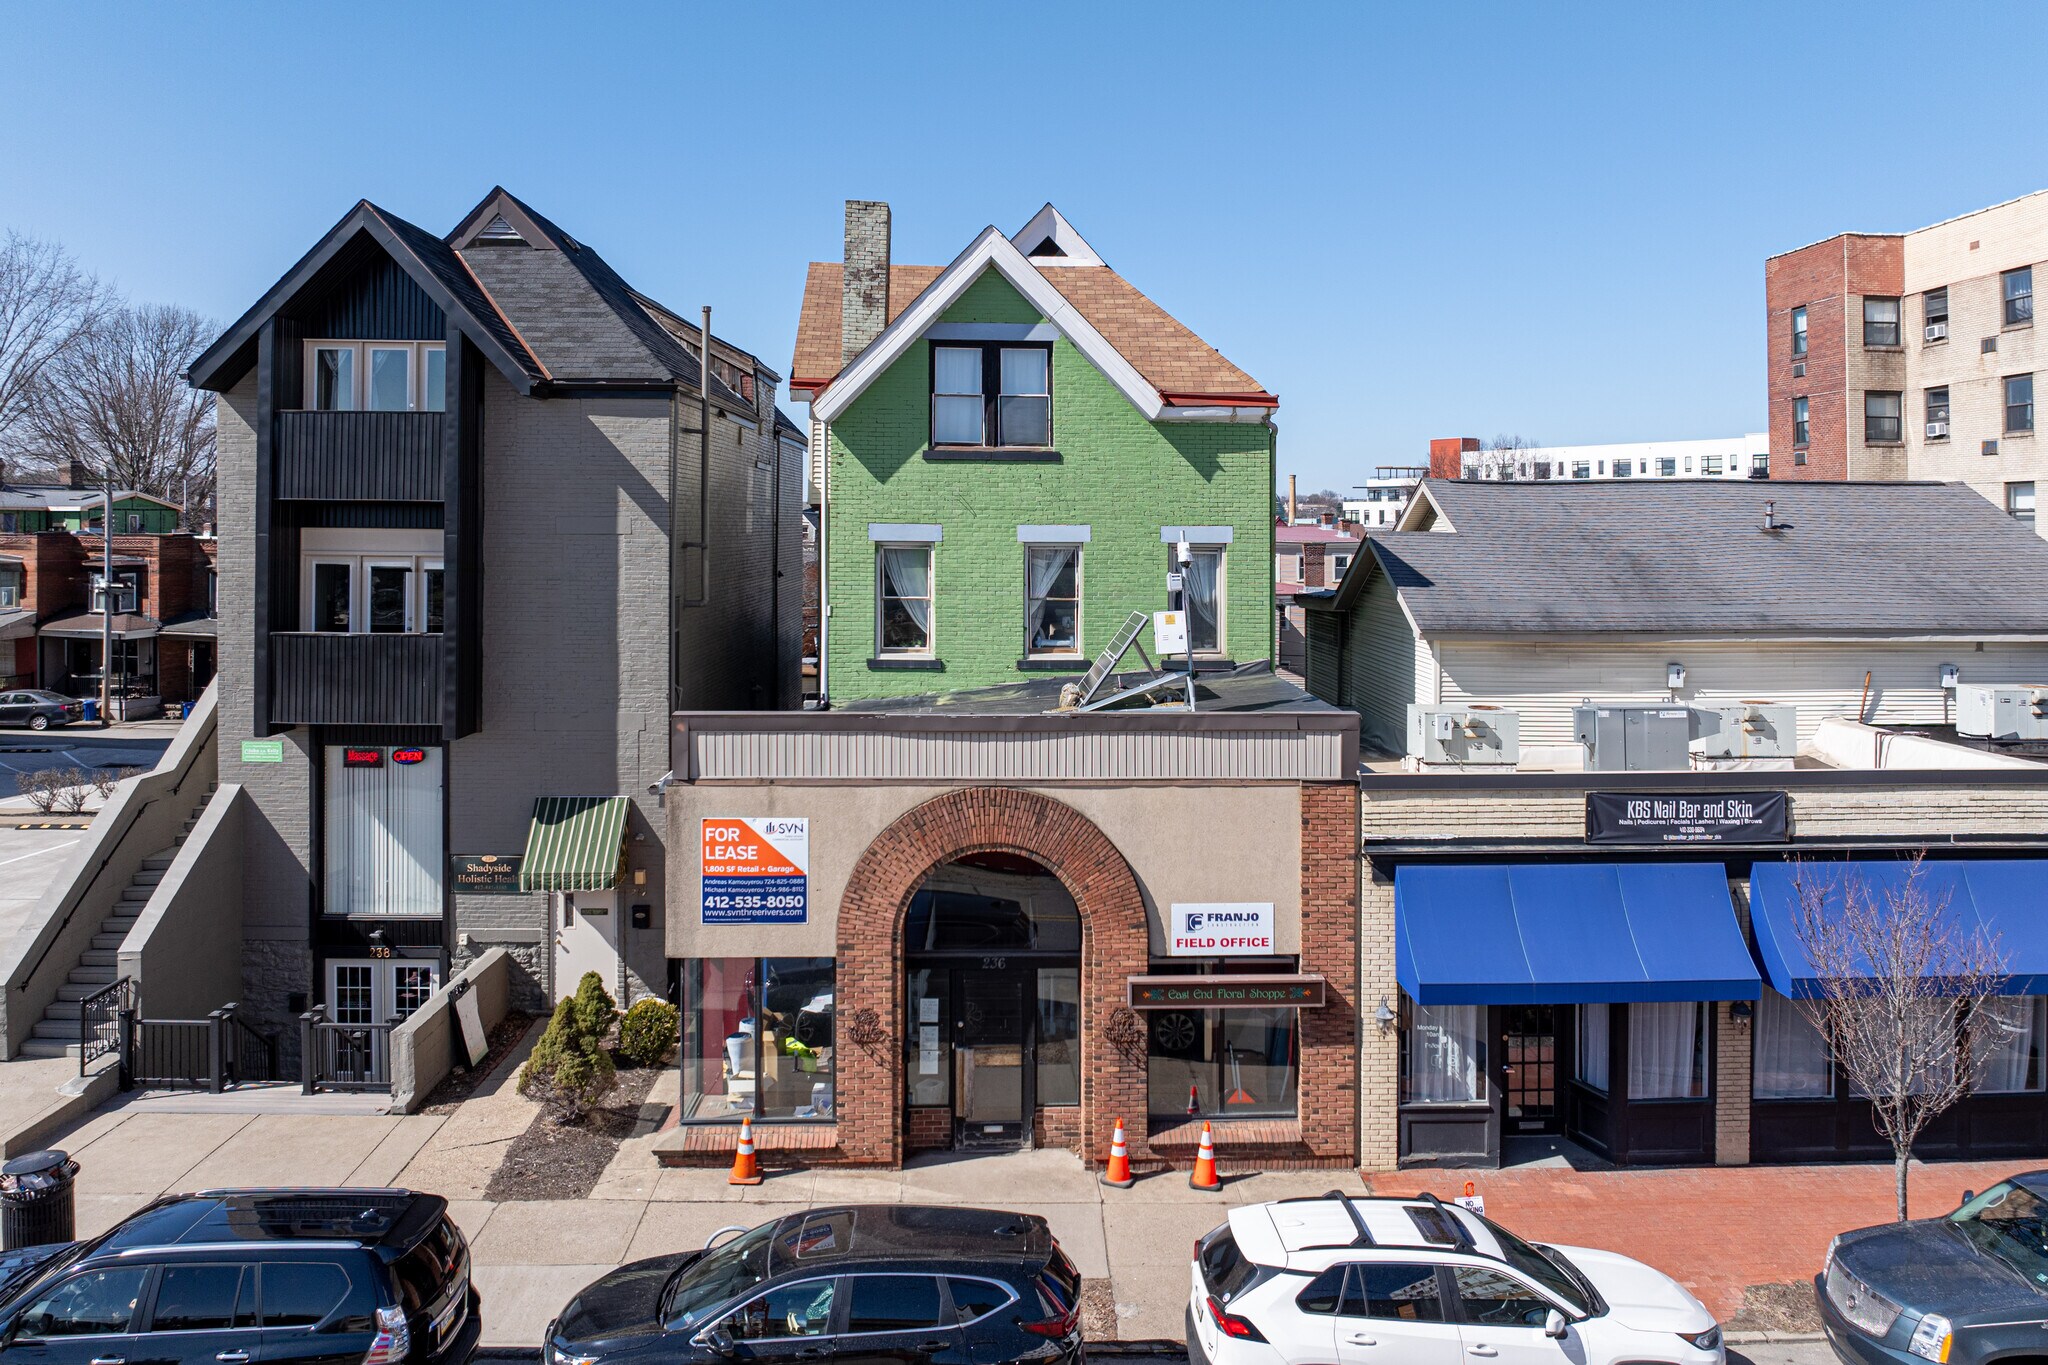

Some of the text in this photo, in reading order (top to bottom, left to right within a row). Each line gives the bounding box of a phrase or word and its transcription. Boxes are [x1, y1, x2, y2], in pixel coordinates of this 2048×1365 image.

[347, 749, 379, 763] Massage
[393, 751, 423, 761] OPEN
[1627, 800, 1753, 819] KBS Nail Bar and Skin
[778, 823, 804, 834] SVN
[705, 827, 740, 842] FOR
[705, 845, 758, 860] LEASE
[466, 863, 512, 874] Shadyside
[704, 865, 725, 873] 1,800
[767, 865, 795, 873] Garage
[457, 874, 492, 883] Holistic
[728, 878, 763, 886] Kamouyerou
[704, 895, 804, 908] 412-535-8050
[704, 908, 803, 917] www.svnthreerivers.com
[1207, 913, 1260, 922] FRANJO
[1176, 937, 1270, 948] FIELD OFFICE
[369, 947, 391, 958] 238
[982, 956, 1006, 970] 236
[1168, 987, 1287, 1000] East End Floral Shoppe
